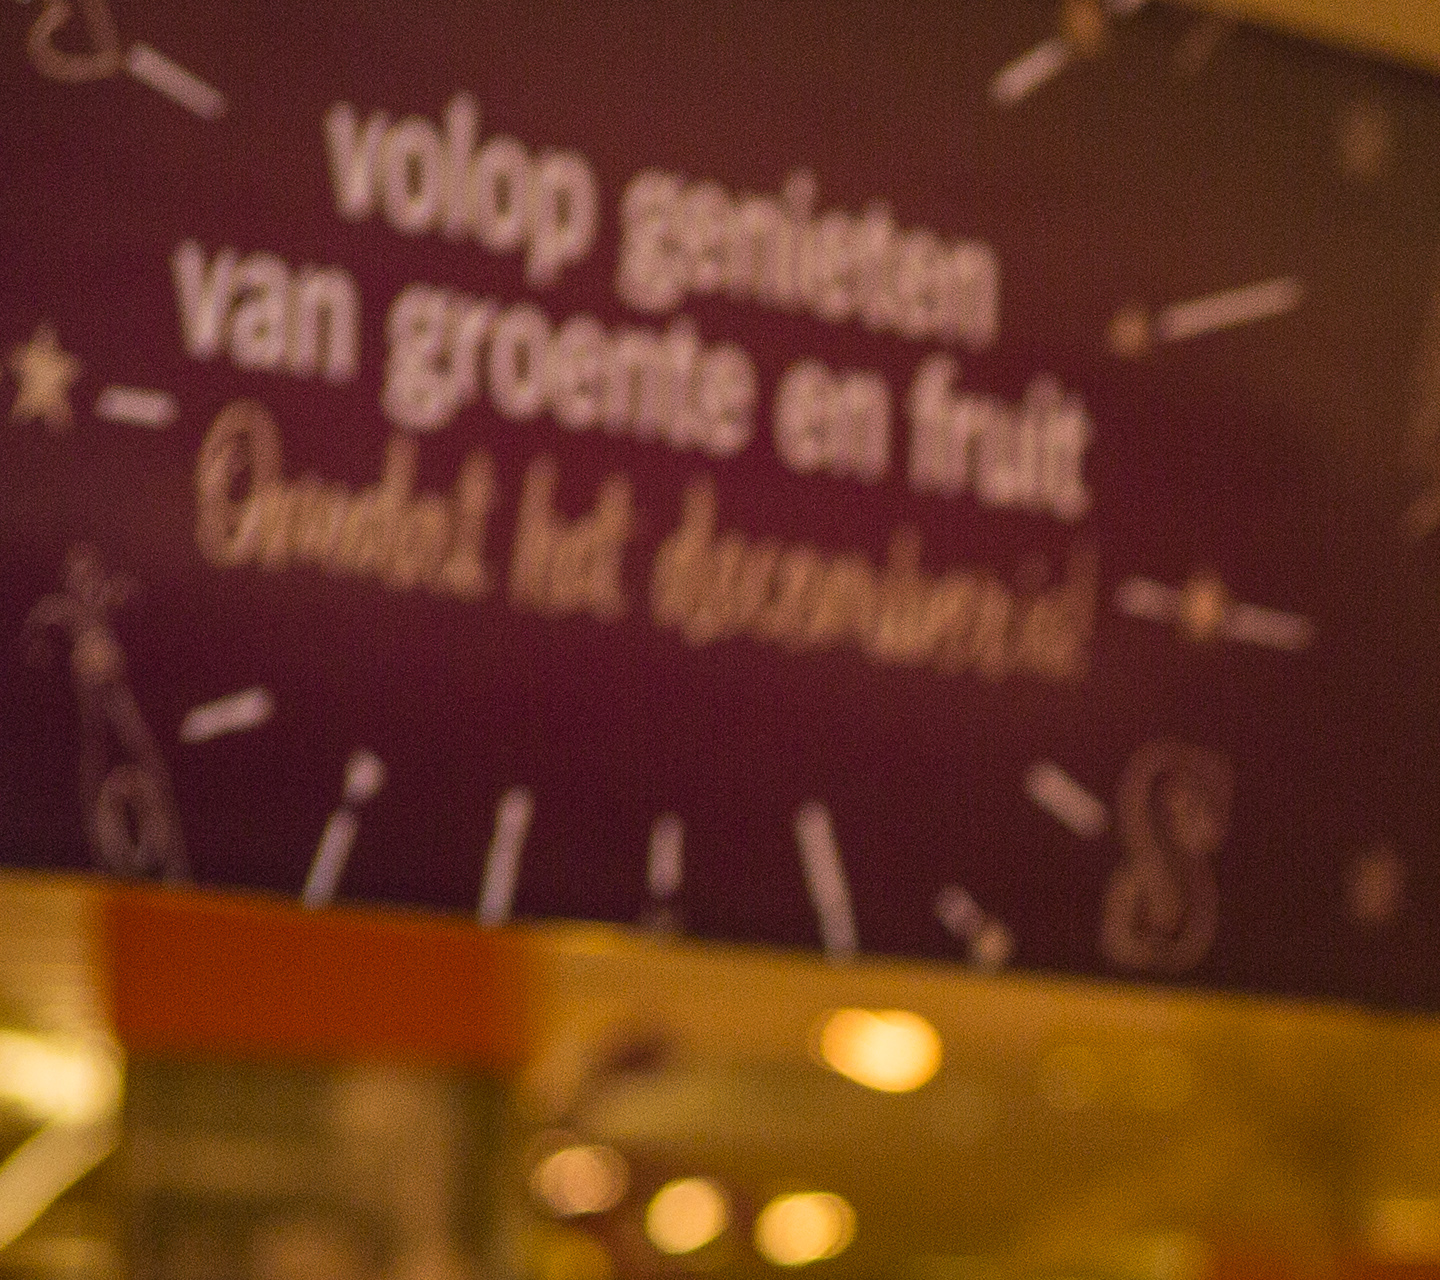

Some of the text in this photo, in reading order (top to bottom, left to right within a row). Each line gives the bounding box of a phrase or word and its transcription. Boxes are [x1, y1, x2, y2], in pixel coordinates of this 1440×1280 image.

[325, 91, 1000, 348] volop genieten
[172, 240, 1096, 521] van groente en fruit
